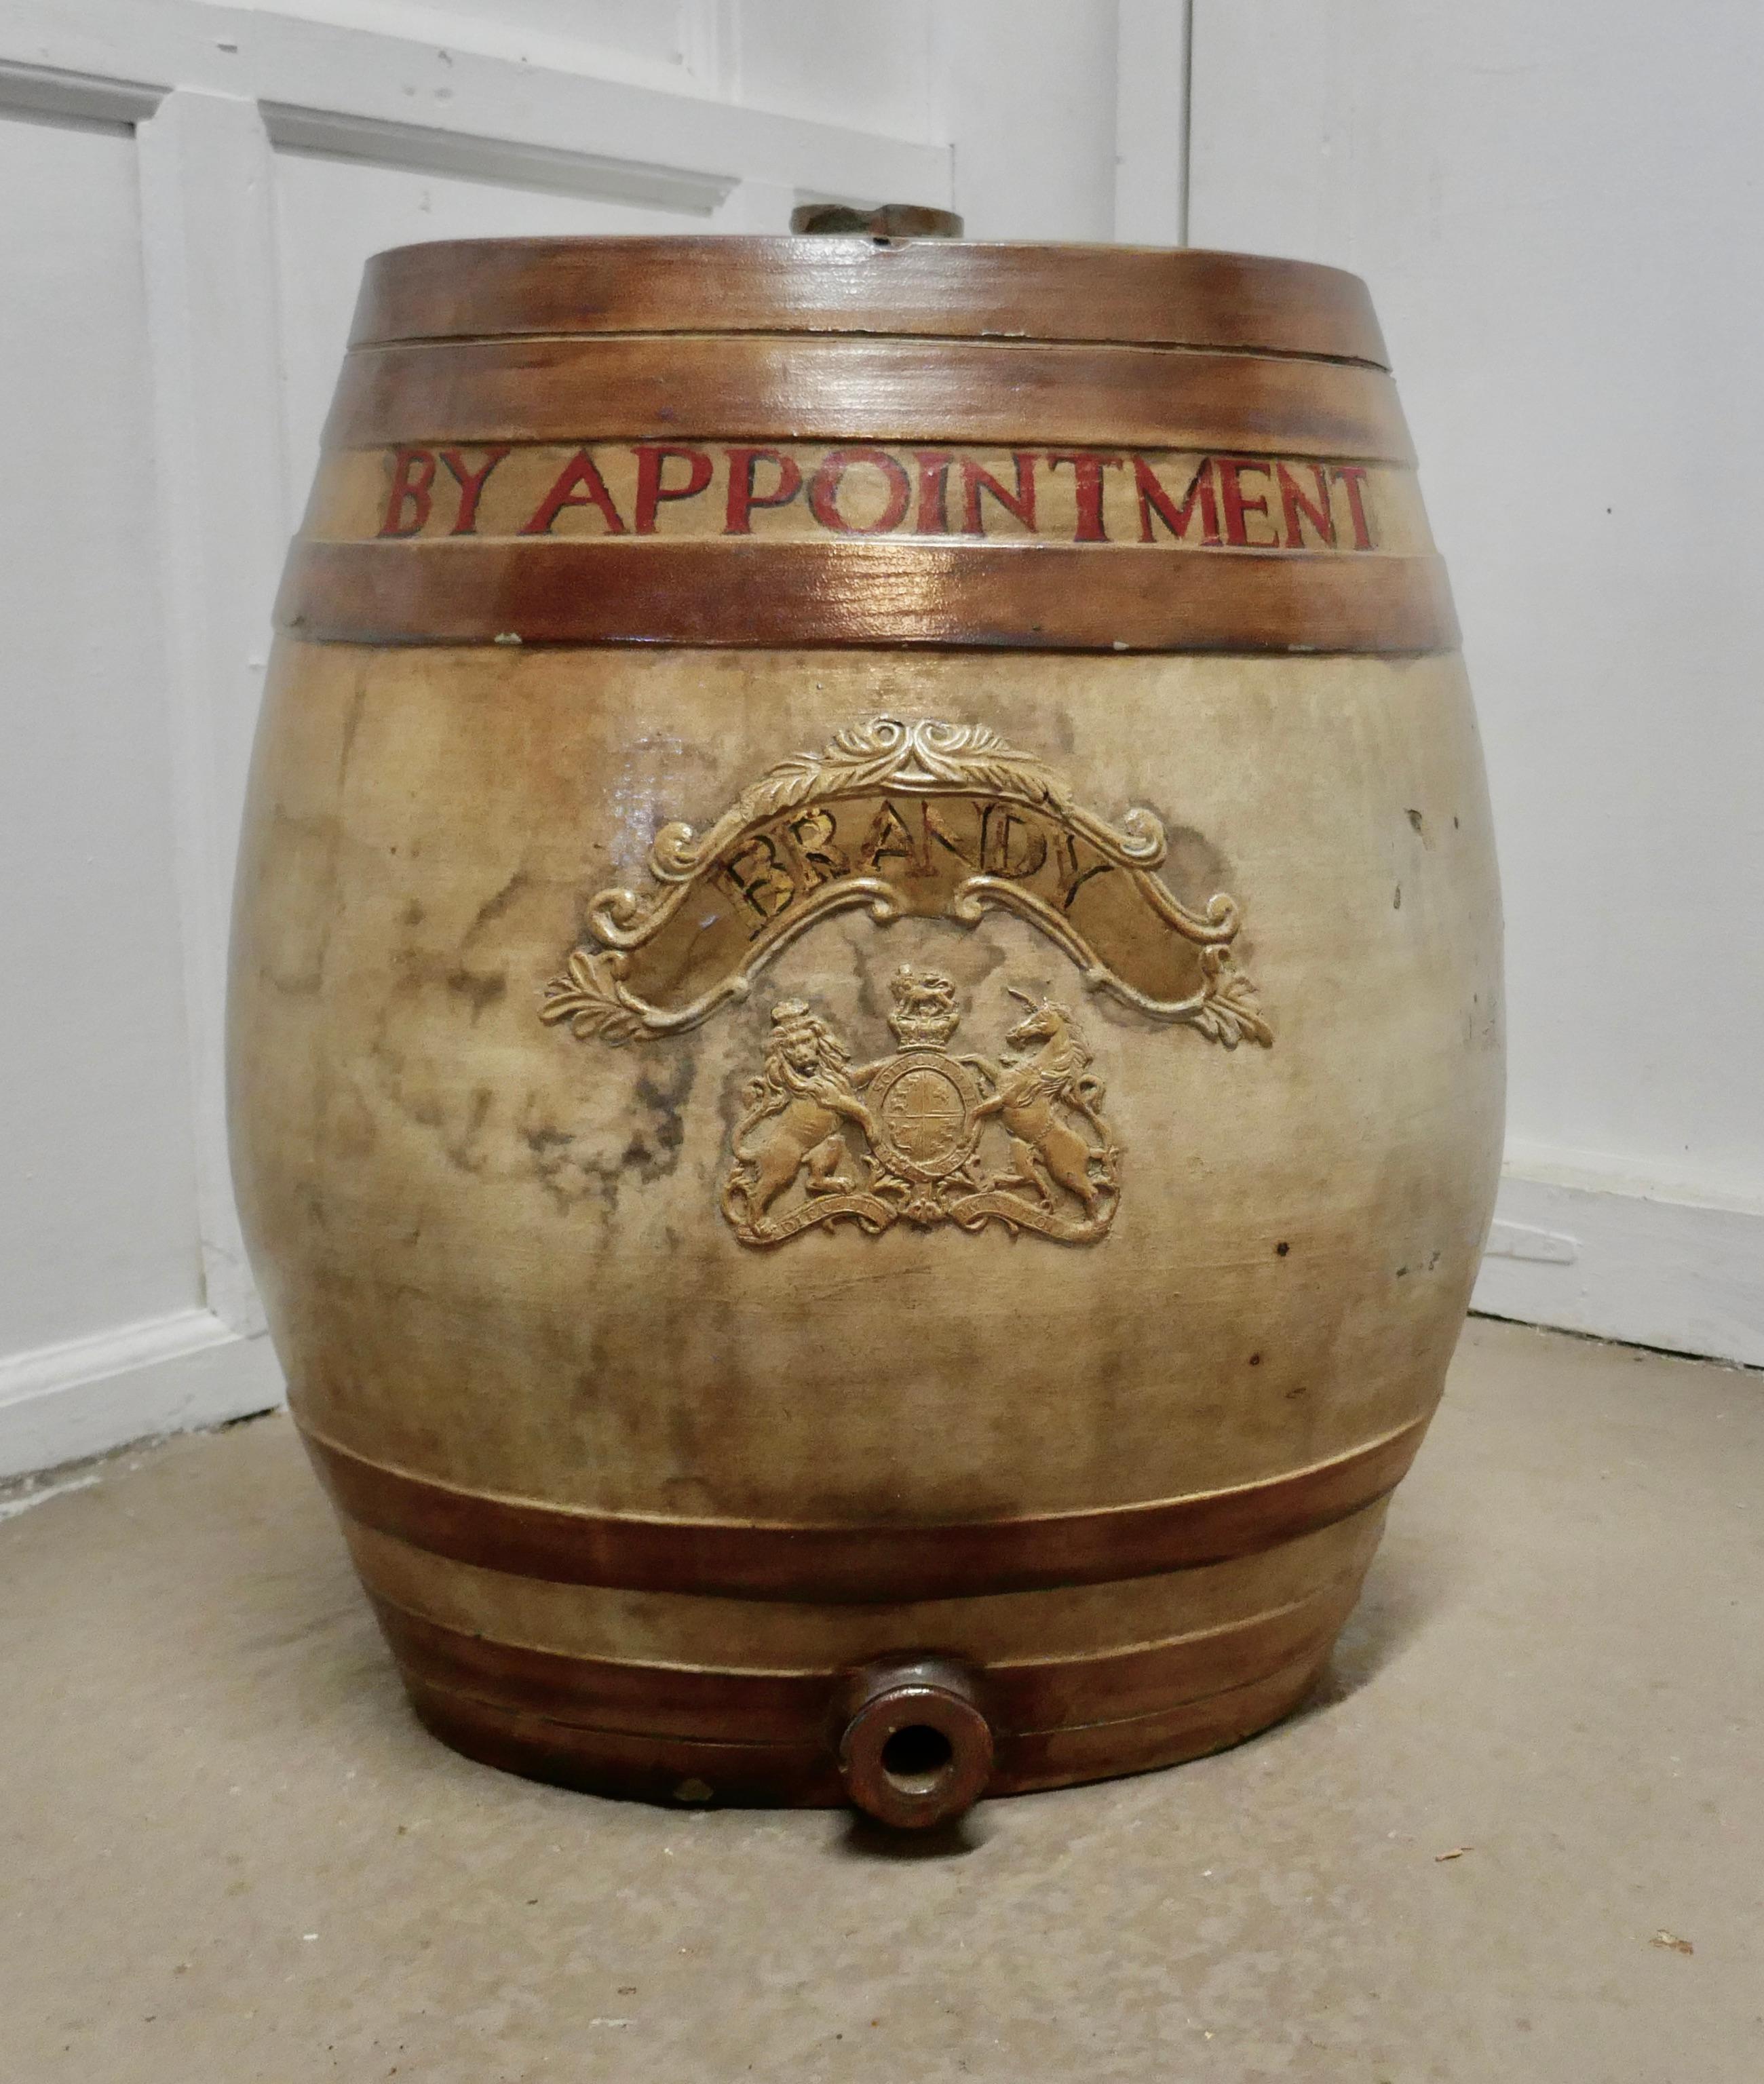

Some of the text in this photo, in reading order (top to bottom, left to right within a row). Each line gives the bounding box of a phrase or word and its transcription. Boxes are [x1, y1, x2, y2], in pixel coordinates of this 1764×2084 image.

[377, 444, 1379, 552] BY APPOINTMENT
[721, 800, 1114, 942] BRANDY
